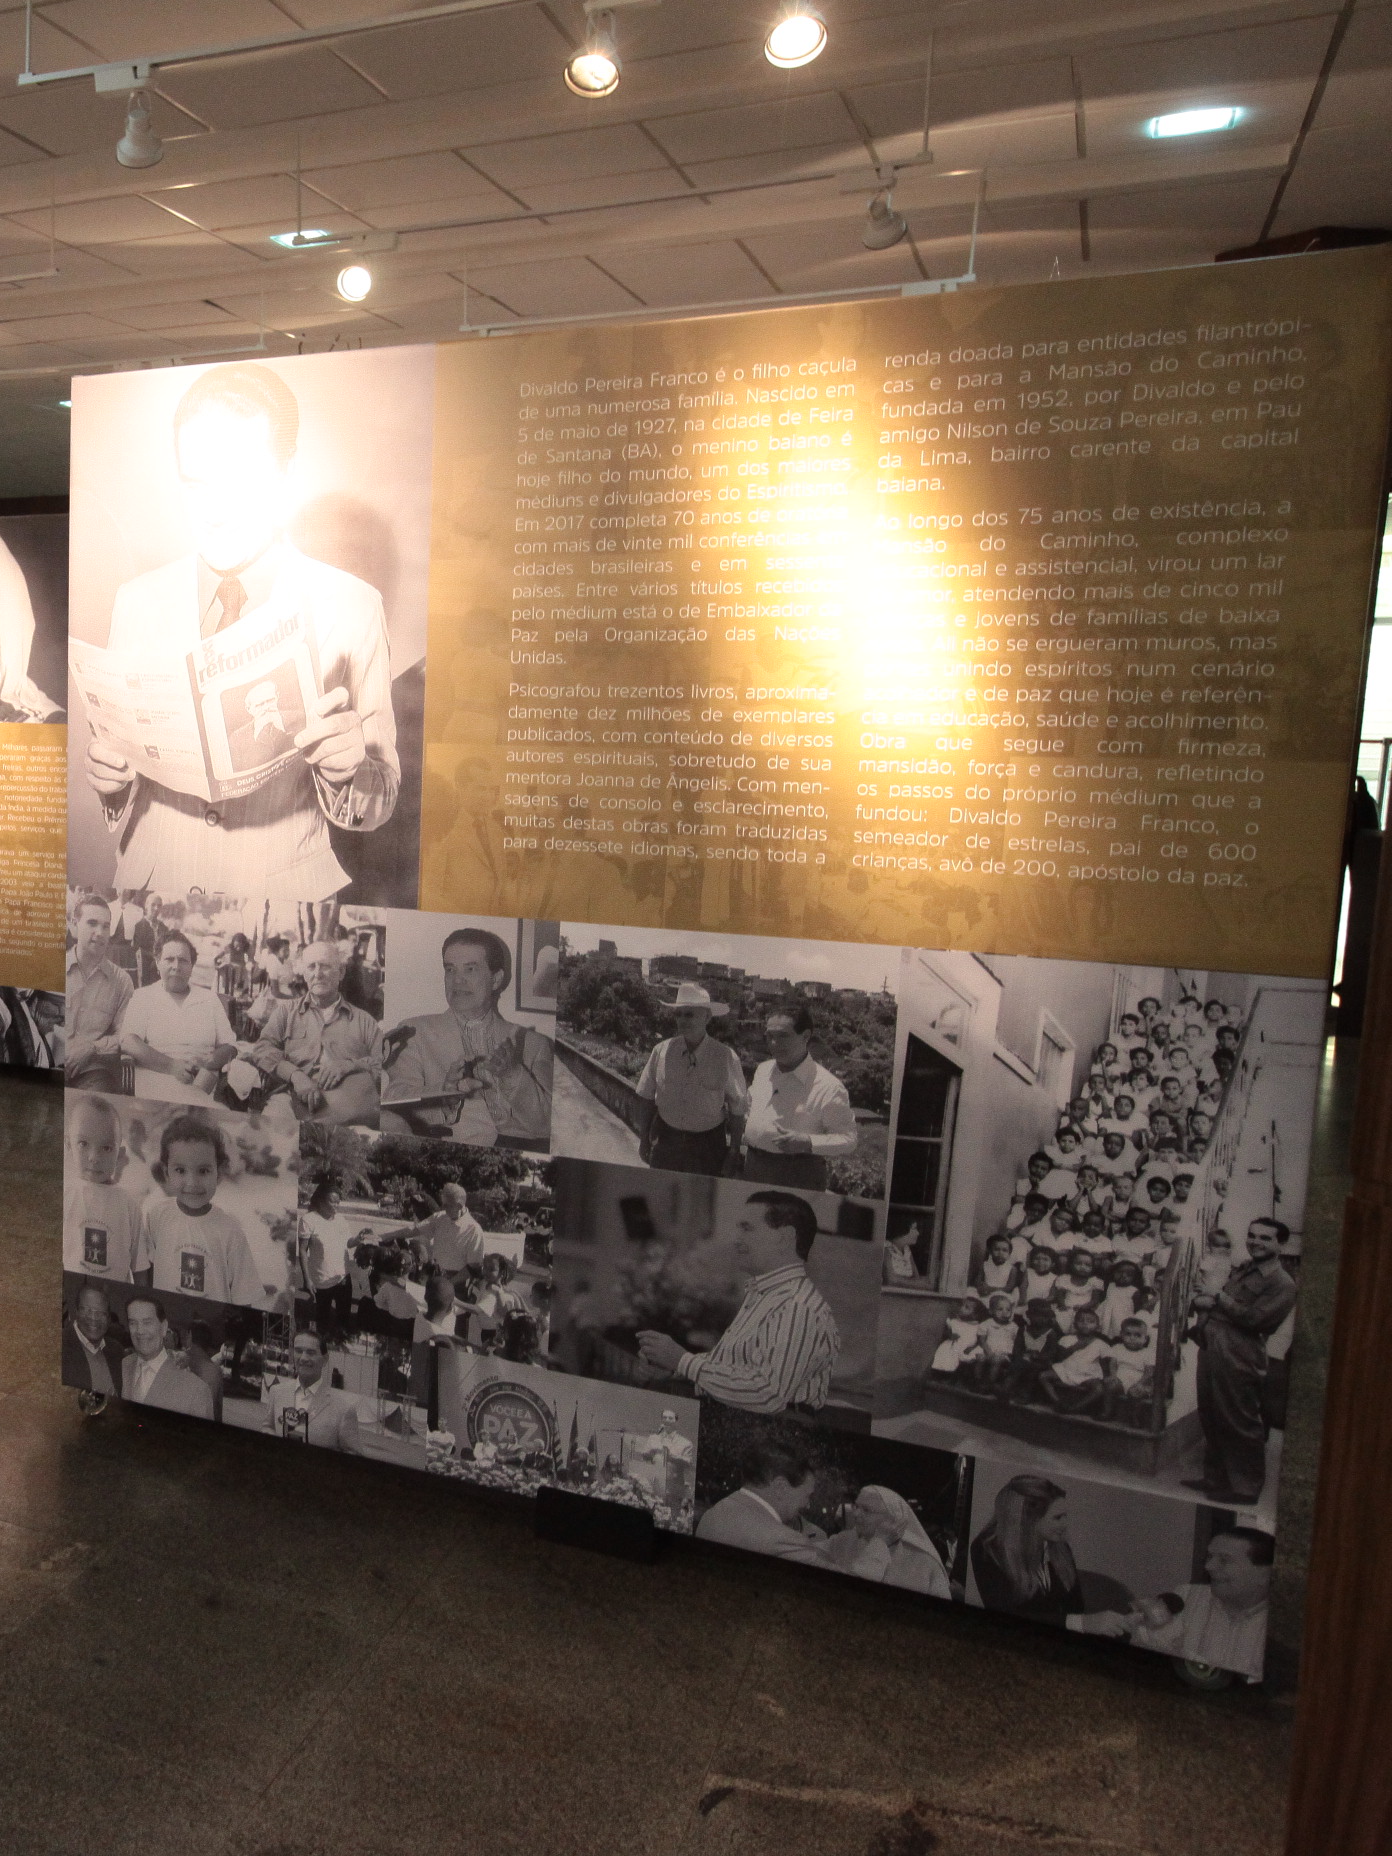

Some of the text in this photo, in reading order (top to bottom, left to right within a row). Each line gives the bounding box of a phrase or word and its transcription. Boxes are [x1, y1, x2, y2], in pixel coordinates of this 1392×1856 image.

[884, 314, 1311, 368] renda doada para entidades filantrópi-
[520, 354, 857, 397] Divaldo Pereira Franco é o filho caçula
[882, 344, 1306, 393] cas e para a Mansão do Caminho,
[518, 382, 856, 420] de uma numerosa família. Nascido em
[881, 371, 1305, 418] fundada em 1952, por Divaldo e pelo
[518, 405, 854, 442] 5 de maio de 1927, na cidade de Feira
[879, 401, 1301, 446] amigo Nilson de Souza Pereira, em Pau
[517, 428, 853, 465] de Santana (BA), o menino baiano é
[877, 426, 1299, 468] da Lima, bairro carente da capital
[876, 474, 945, 493] baiana.
[198, 612, 299, 683] reformador
[509, 682, 836, 703] Psicografou trezentos livros, aproxima-
[508, 703, 836, 726] damente dez milhões de exemplares
[507, 725, 834, 746] publicados, com conteúdo de diversos
[506, 748, 832, 770] autores espirituais, sobretudo de sua
[505, 770, 830, 793] mentora Joanna de Ângelis. Com men-
[504, 792, 828, 819] sagens de consolo e esclarecimento,
[855, 802, 1260, 835] fundou: Divaldo Pereira Franco, o
[504, 812, 828, 840] muitas destas obras foram traduzidas
[503, 834, 826, 863] para dezessete idiomas, sendo toda a
[853, 829, 1257, 861] semeador de estrelas, pai de 600
[852, 851, 1247, 889] crianças, avô de 200, apóstolo da paz.
[483, 1413, 539, 1443] PAZ
